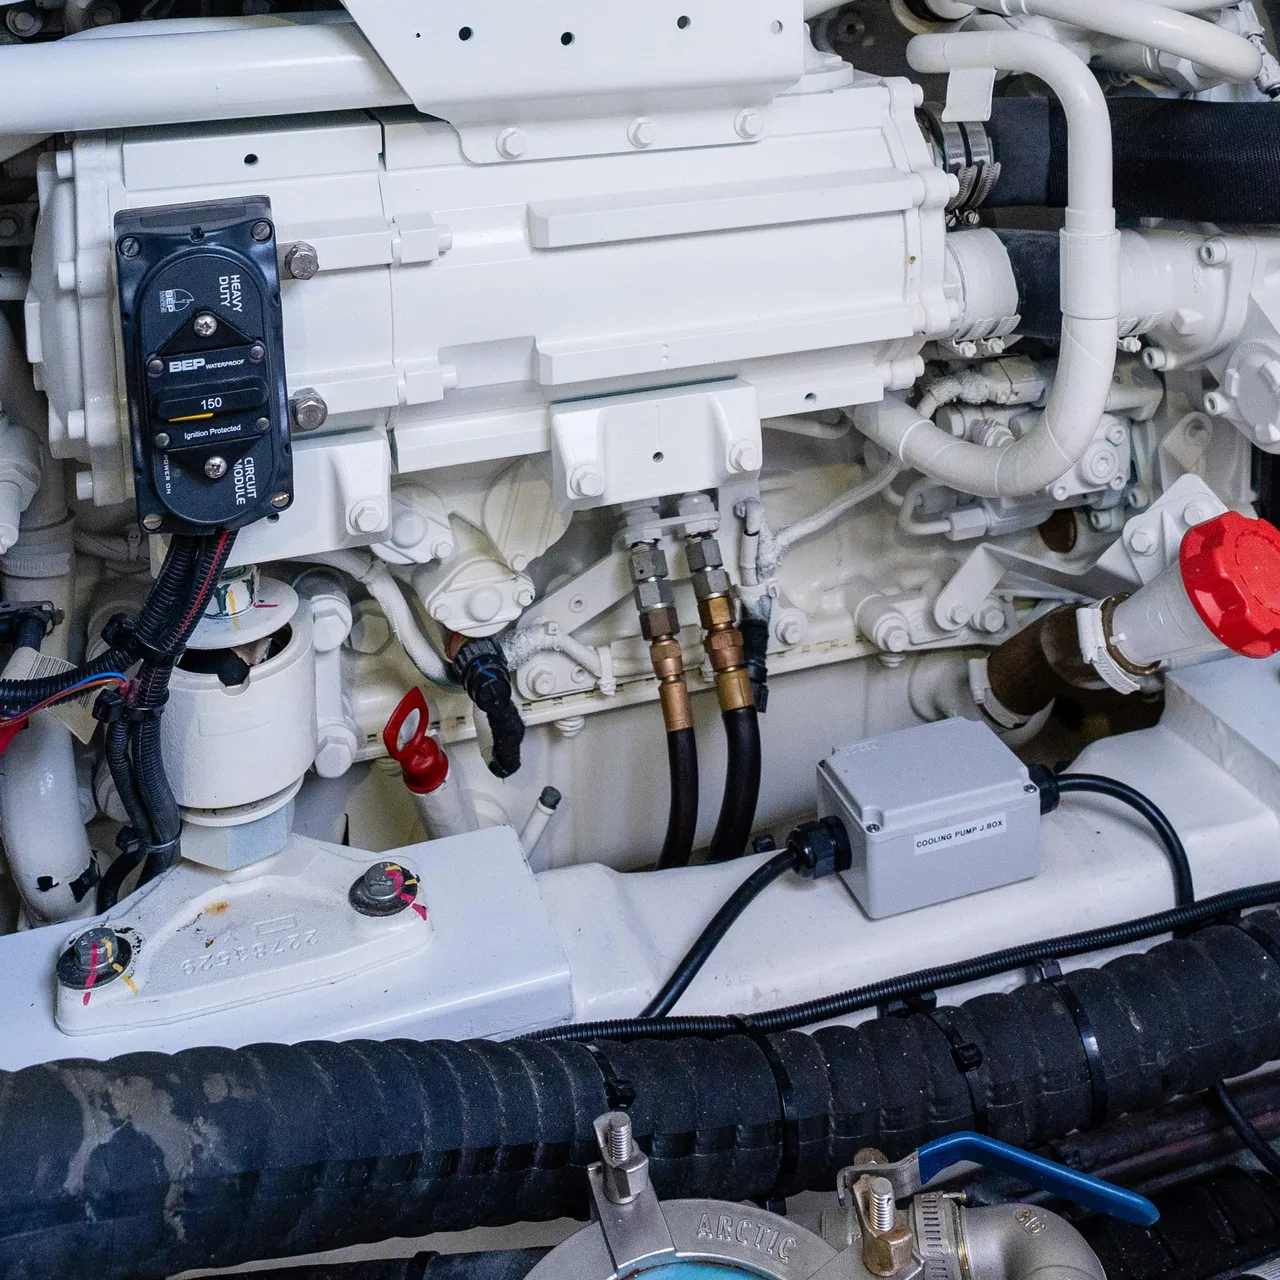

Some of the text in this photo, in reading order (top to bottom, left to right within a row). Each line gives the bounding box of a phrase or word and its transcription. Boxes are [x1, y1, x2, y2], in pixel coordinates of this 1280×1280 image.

[165, 290, 176, 312] BEP
[219, 276, 231, 307] DUTY
[230, 274, 243, 313] HEAVY
[169, 358, 245, 373] BEP WATERPROOF
[201, 397, 222, 410] 150
[184, 424, 242, 440] Ignition Protected
[163, 454, 172, 495] POWER ON
[233, 459, 246, 505] MODULE
[244, 457, 257, 499] CIRCUIT
[916, 819, 1003, 849] COOLING PUMP J.BOX
[695, 1212, 797, 1263] ARCTIC
[1015, 1209, 1047, 1236] 316
